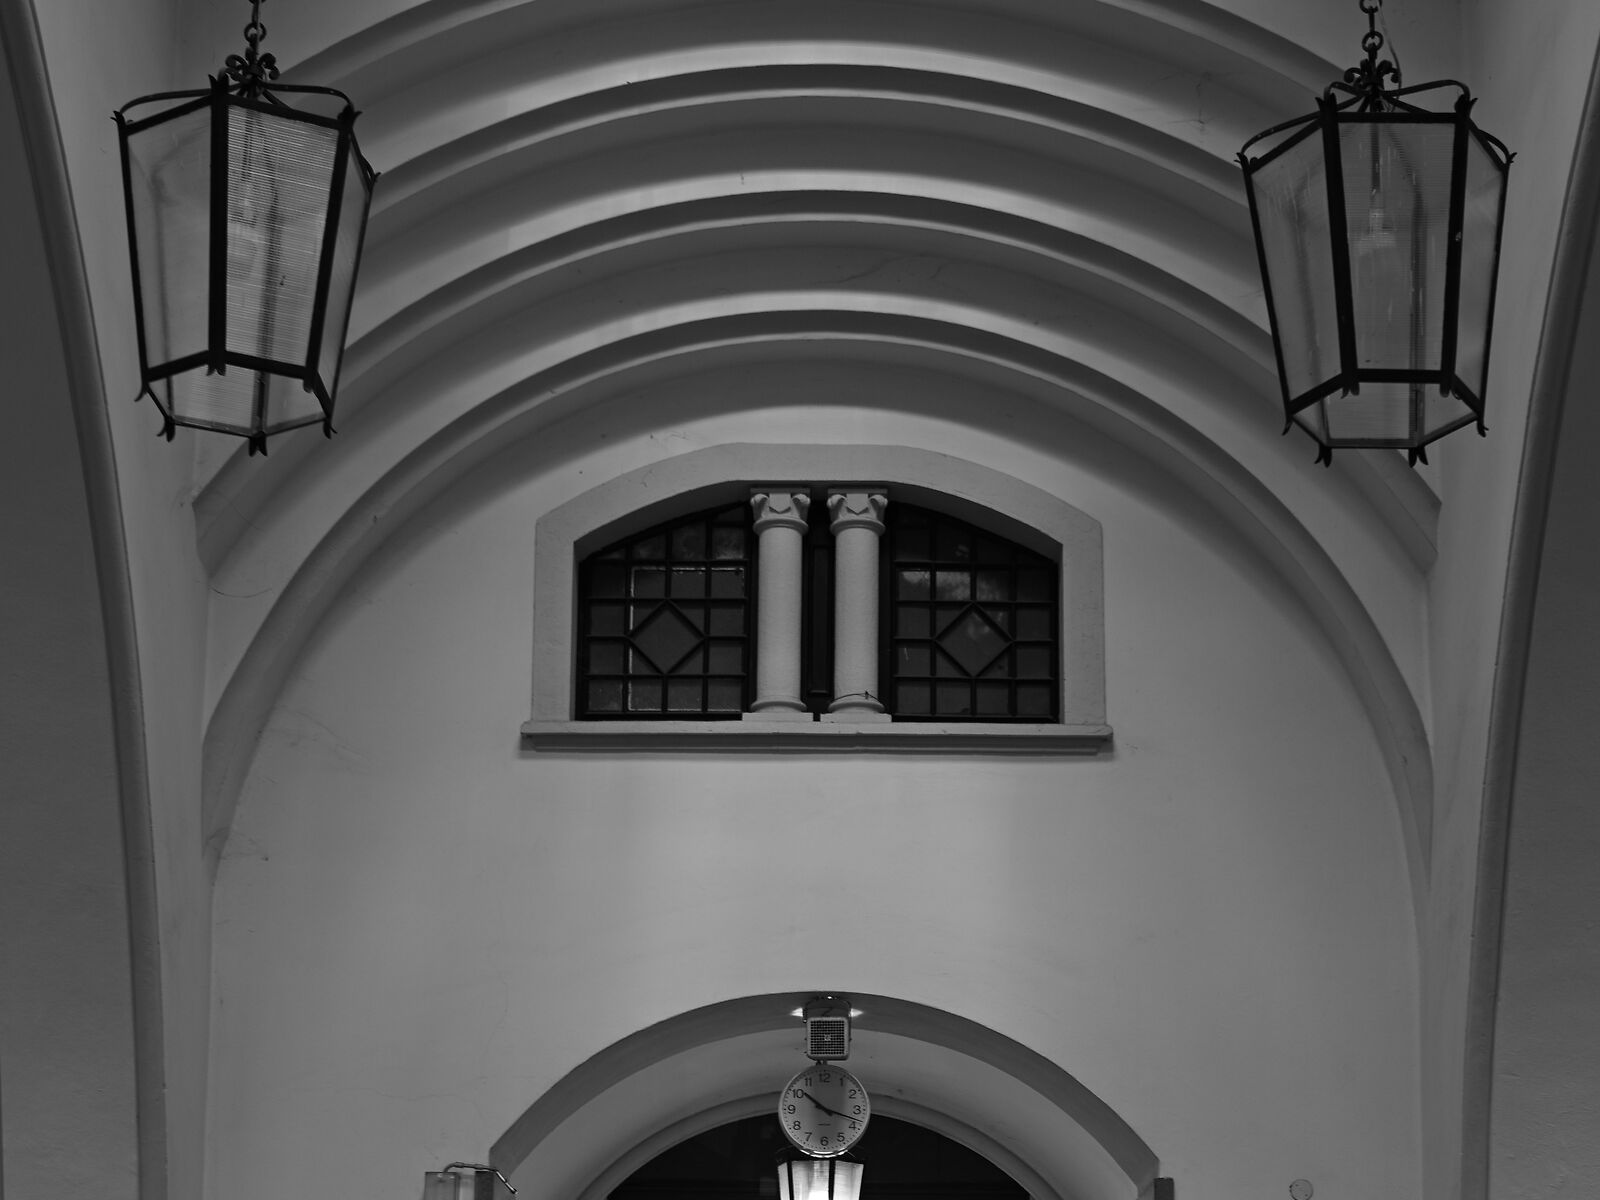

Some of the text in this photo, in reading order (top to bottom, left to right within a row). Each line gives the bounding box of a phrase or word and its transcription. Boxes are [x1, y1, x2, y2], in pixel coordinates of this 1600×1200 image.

[804, 1077, 812, 1086] 11
[818, 1073, 831, 1083] 12
[792, 1089, 804, 1099] 10
[848, 1089, 857, 1099] 2
[787, 1104, 796, 1114] 9
[853, 1105, 861, 1115] 3
[793, 1121, 801, 1130] 8
[848, 1120, 857, 1130] 4
[804, 1132, 812, 1141] 7
[820, 1136, 829, 1146] 6
[837, 1132, 845, 1142] 5
